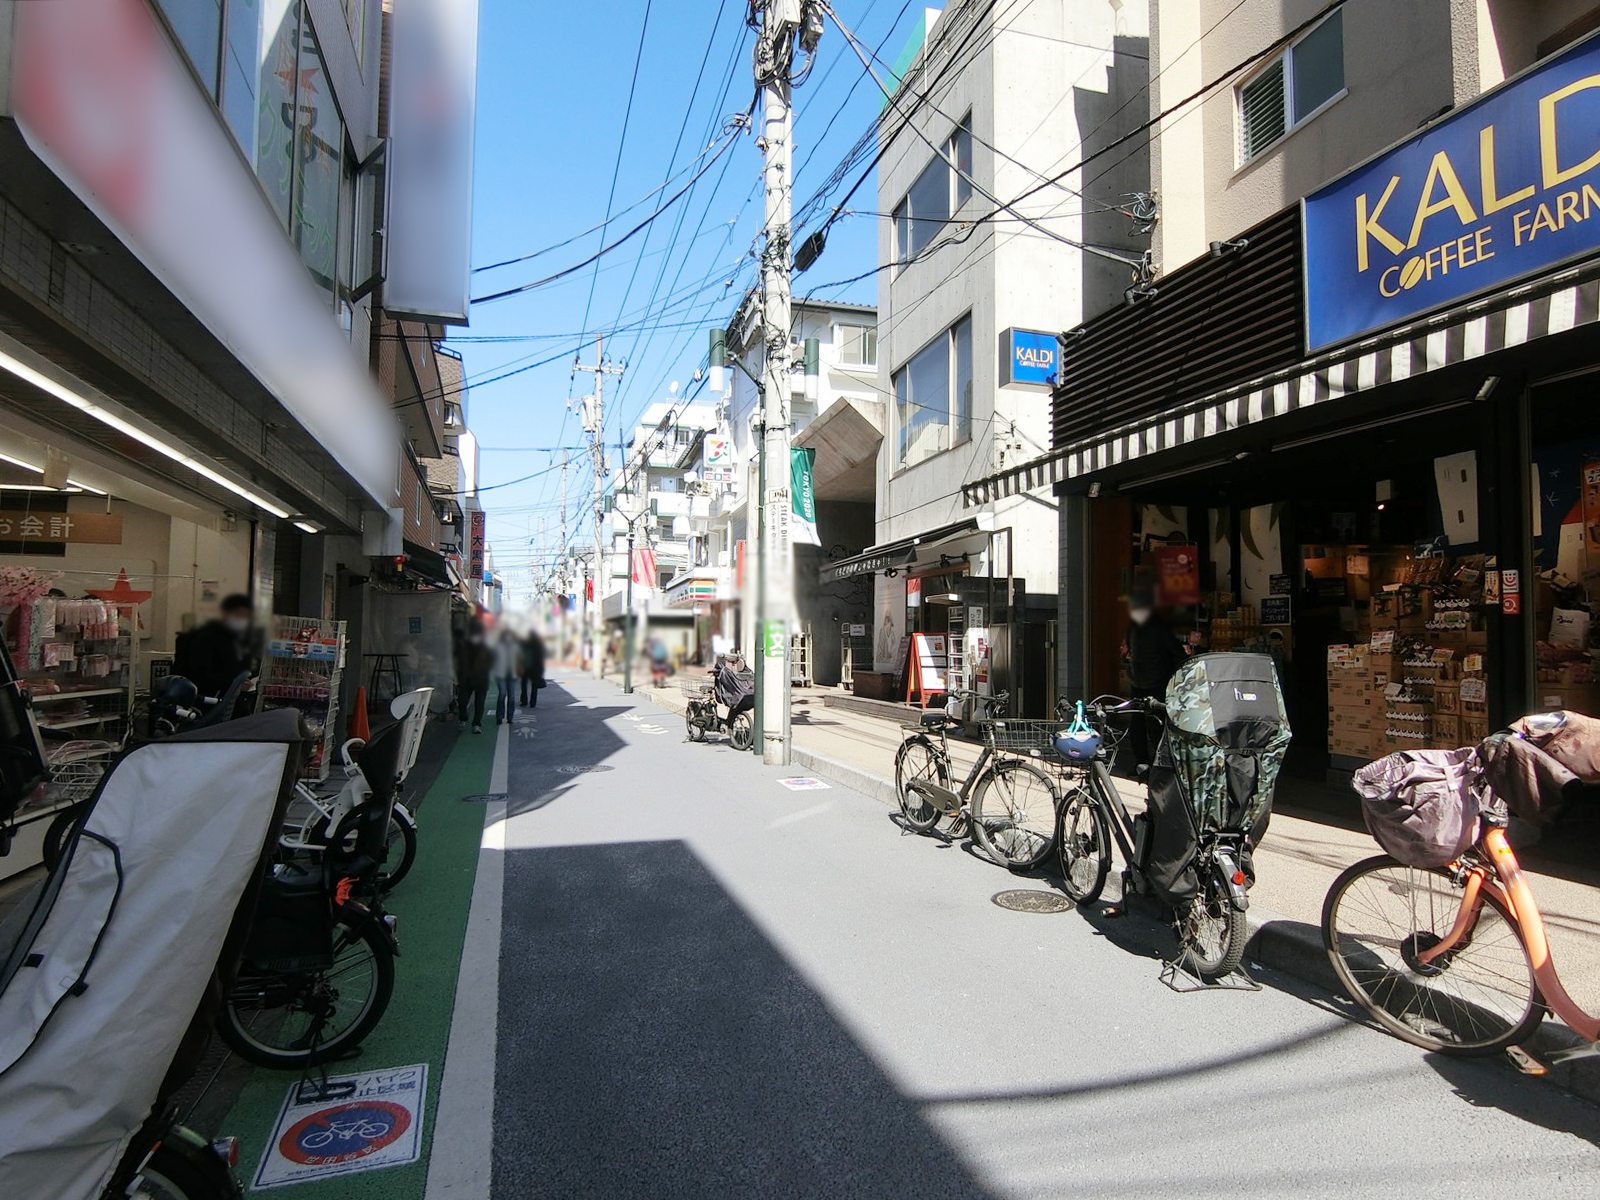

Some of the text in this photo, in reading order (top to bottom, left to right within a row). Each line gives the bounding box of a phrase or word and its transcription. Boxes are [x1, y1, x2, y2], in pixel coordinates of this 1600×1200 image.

[1378, 225, 1496, 299] COFFEE
[1016, 347, 1053, 363] KALDI
[780, 504, 788, 527] STEAK
[803, 497, 812, 518] 2020
[472, 535, 483, 576] 大黒屋
